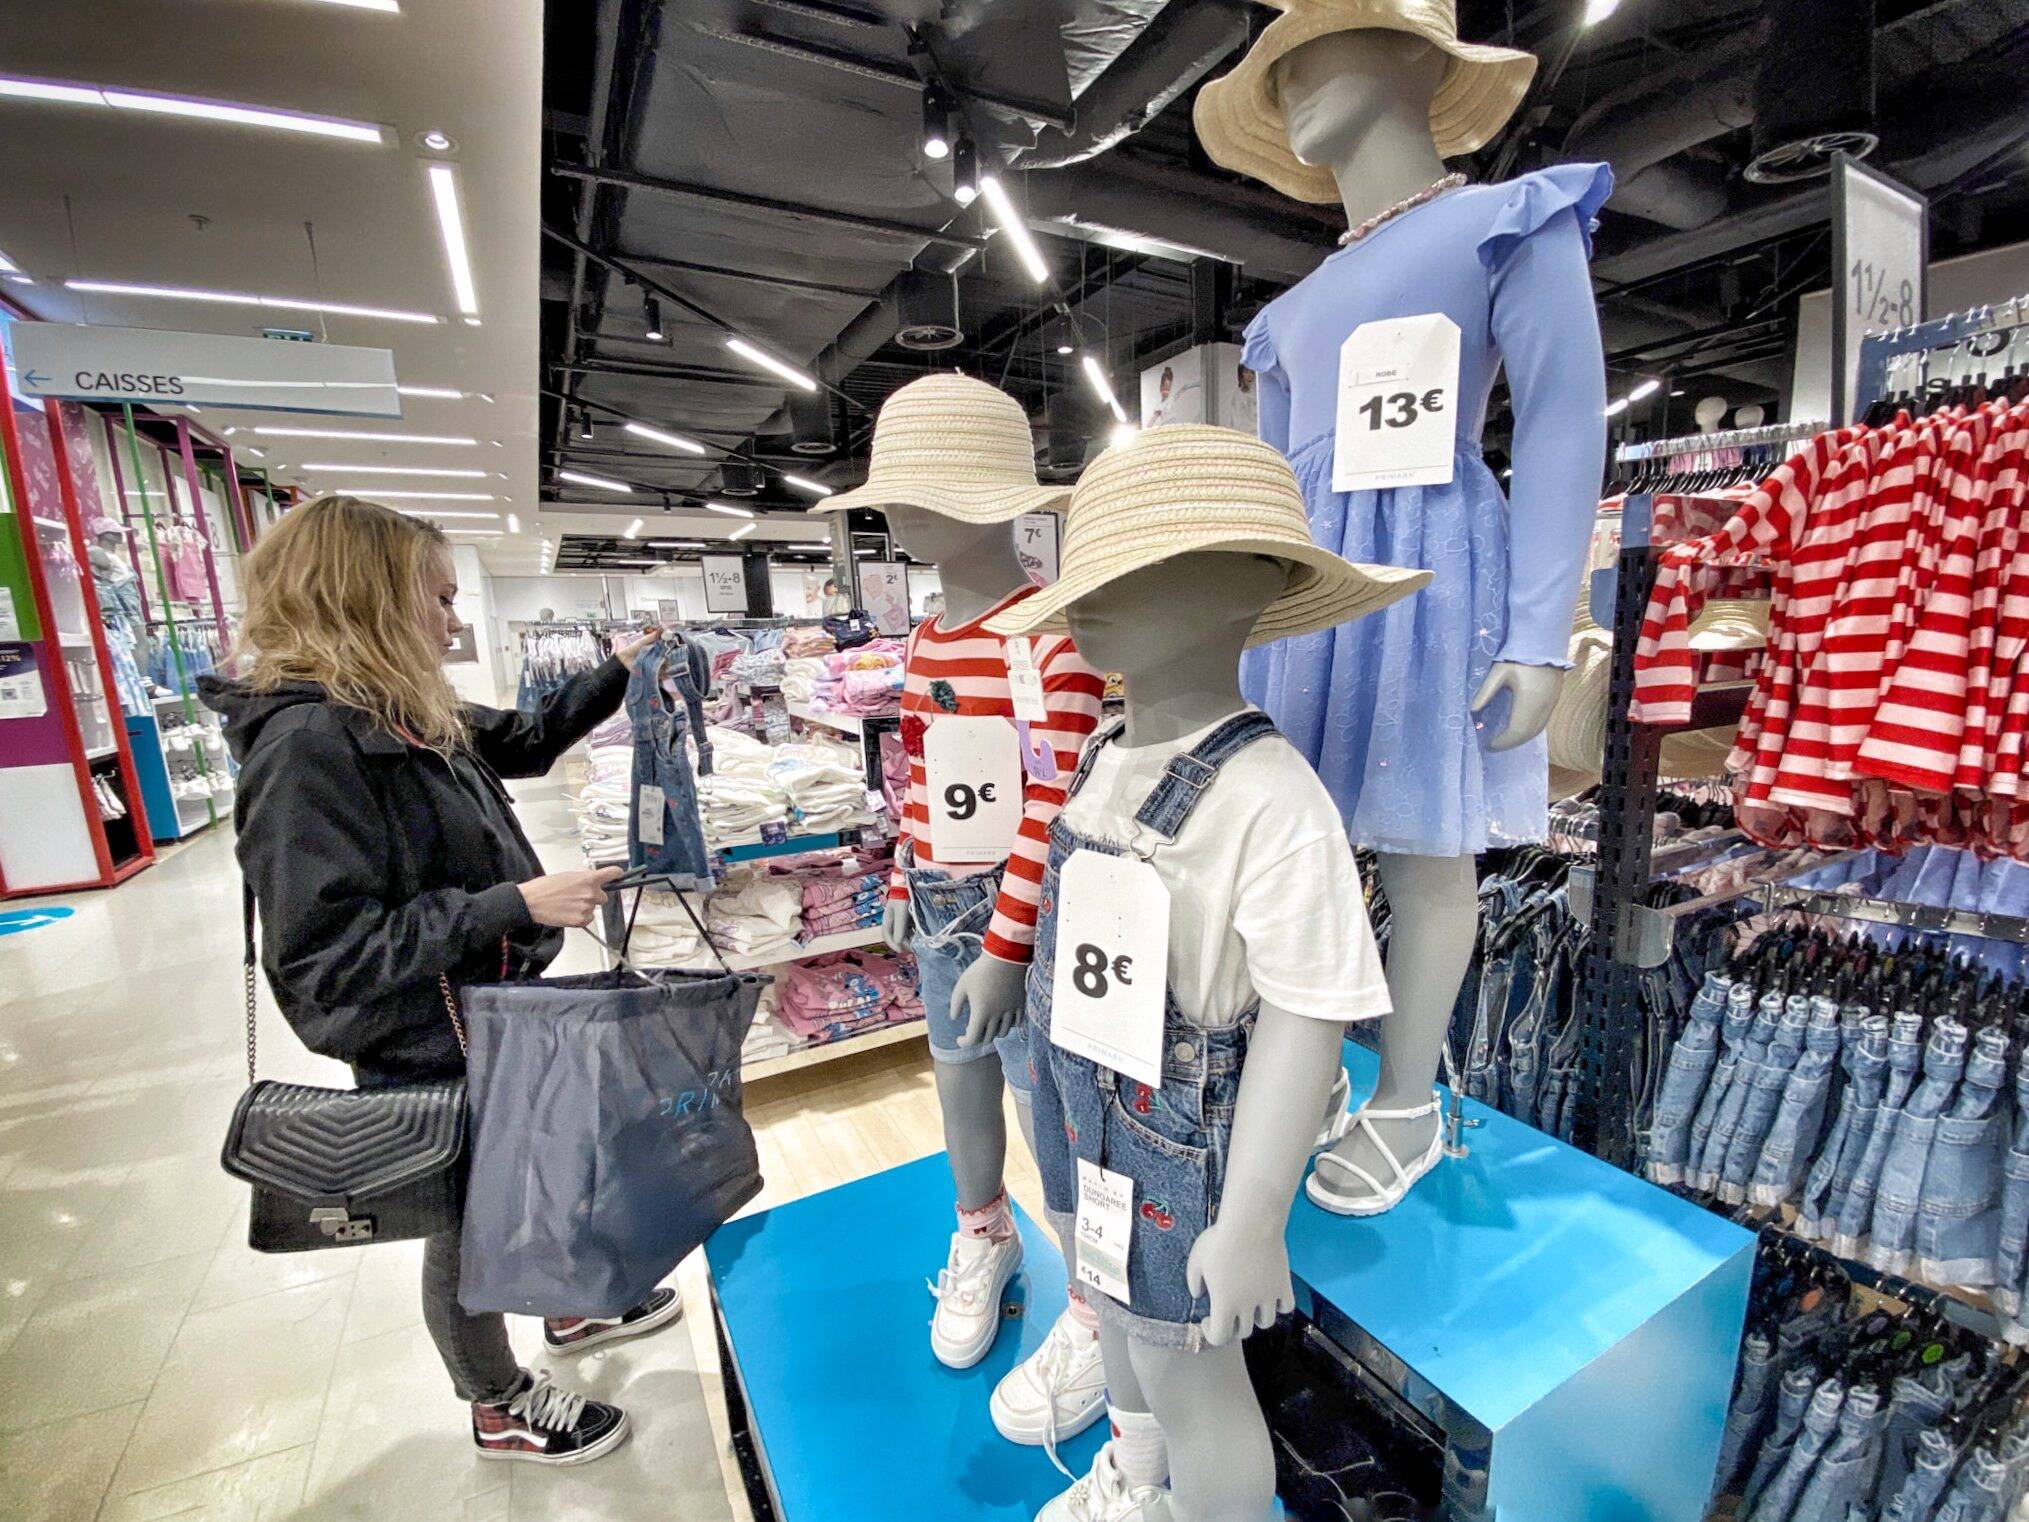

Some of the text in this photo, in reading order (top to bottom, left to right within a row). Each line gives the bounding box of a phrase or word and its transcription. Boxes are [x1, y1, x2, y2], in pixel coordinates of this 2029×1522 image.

[75, 370, 184, 395] CAISSES
[1359, 387, 1444, 431] 13€
[944, 782, 997, 820] 9€
[1072, 942, 1133, 999] 8€
[1082, 1216, 1103, 1239] 3-4
